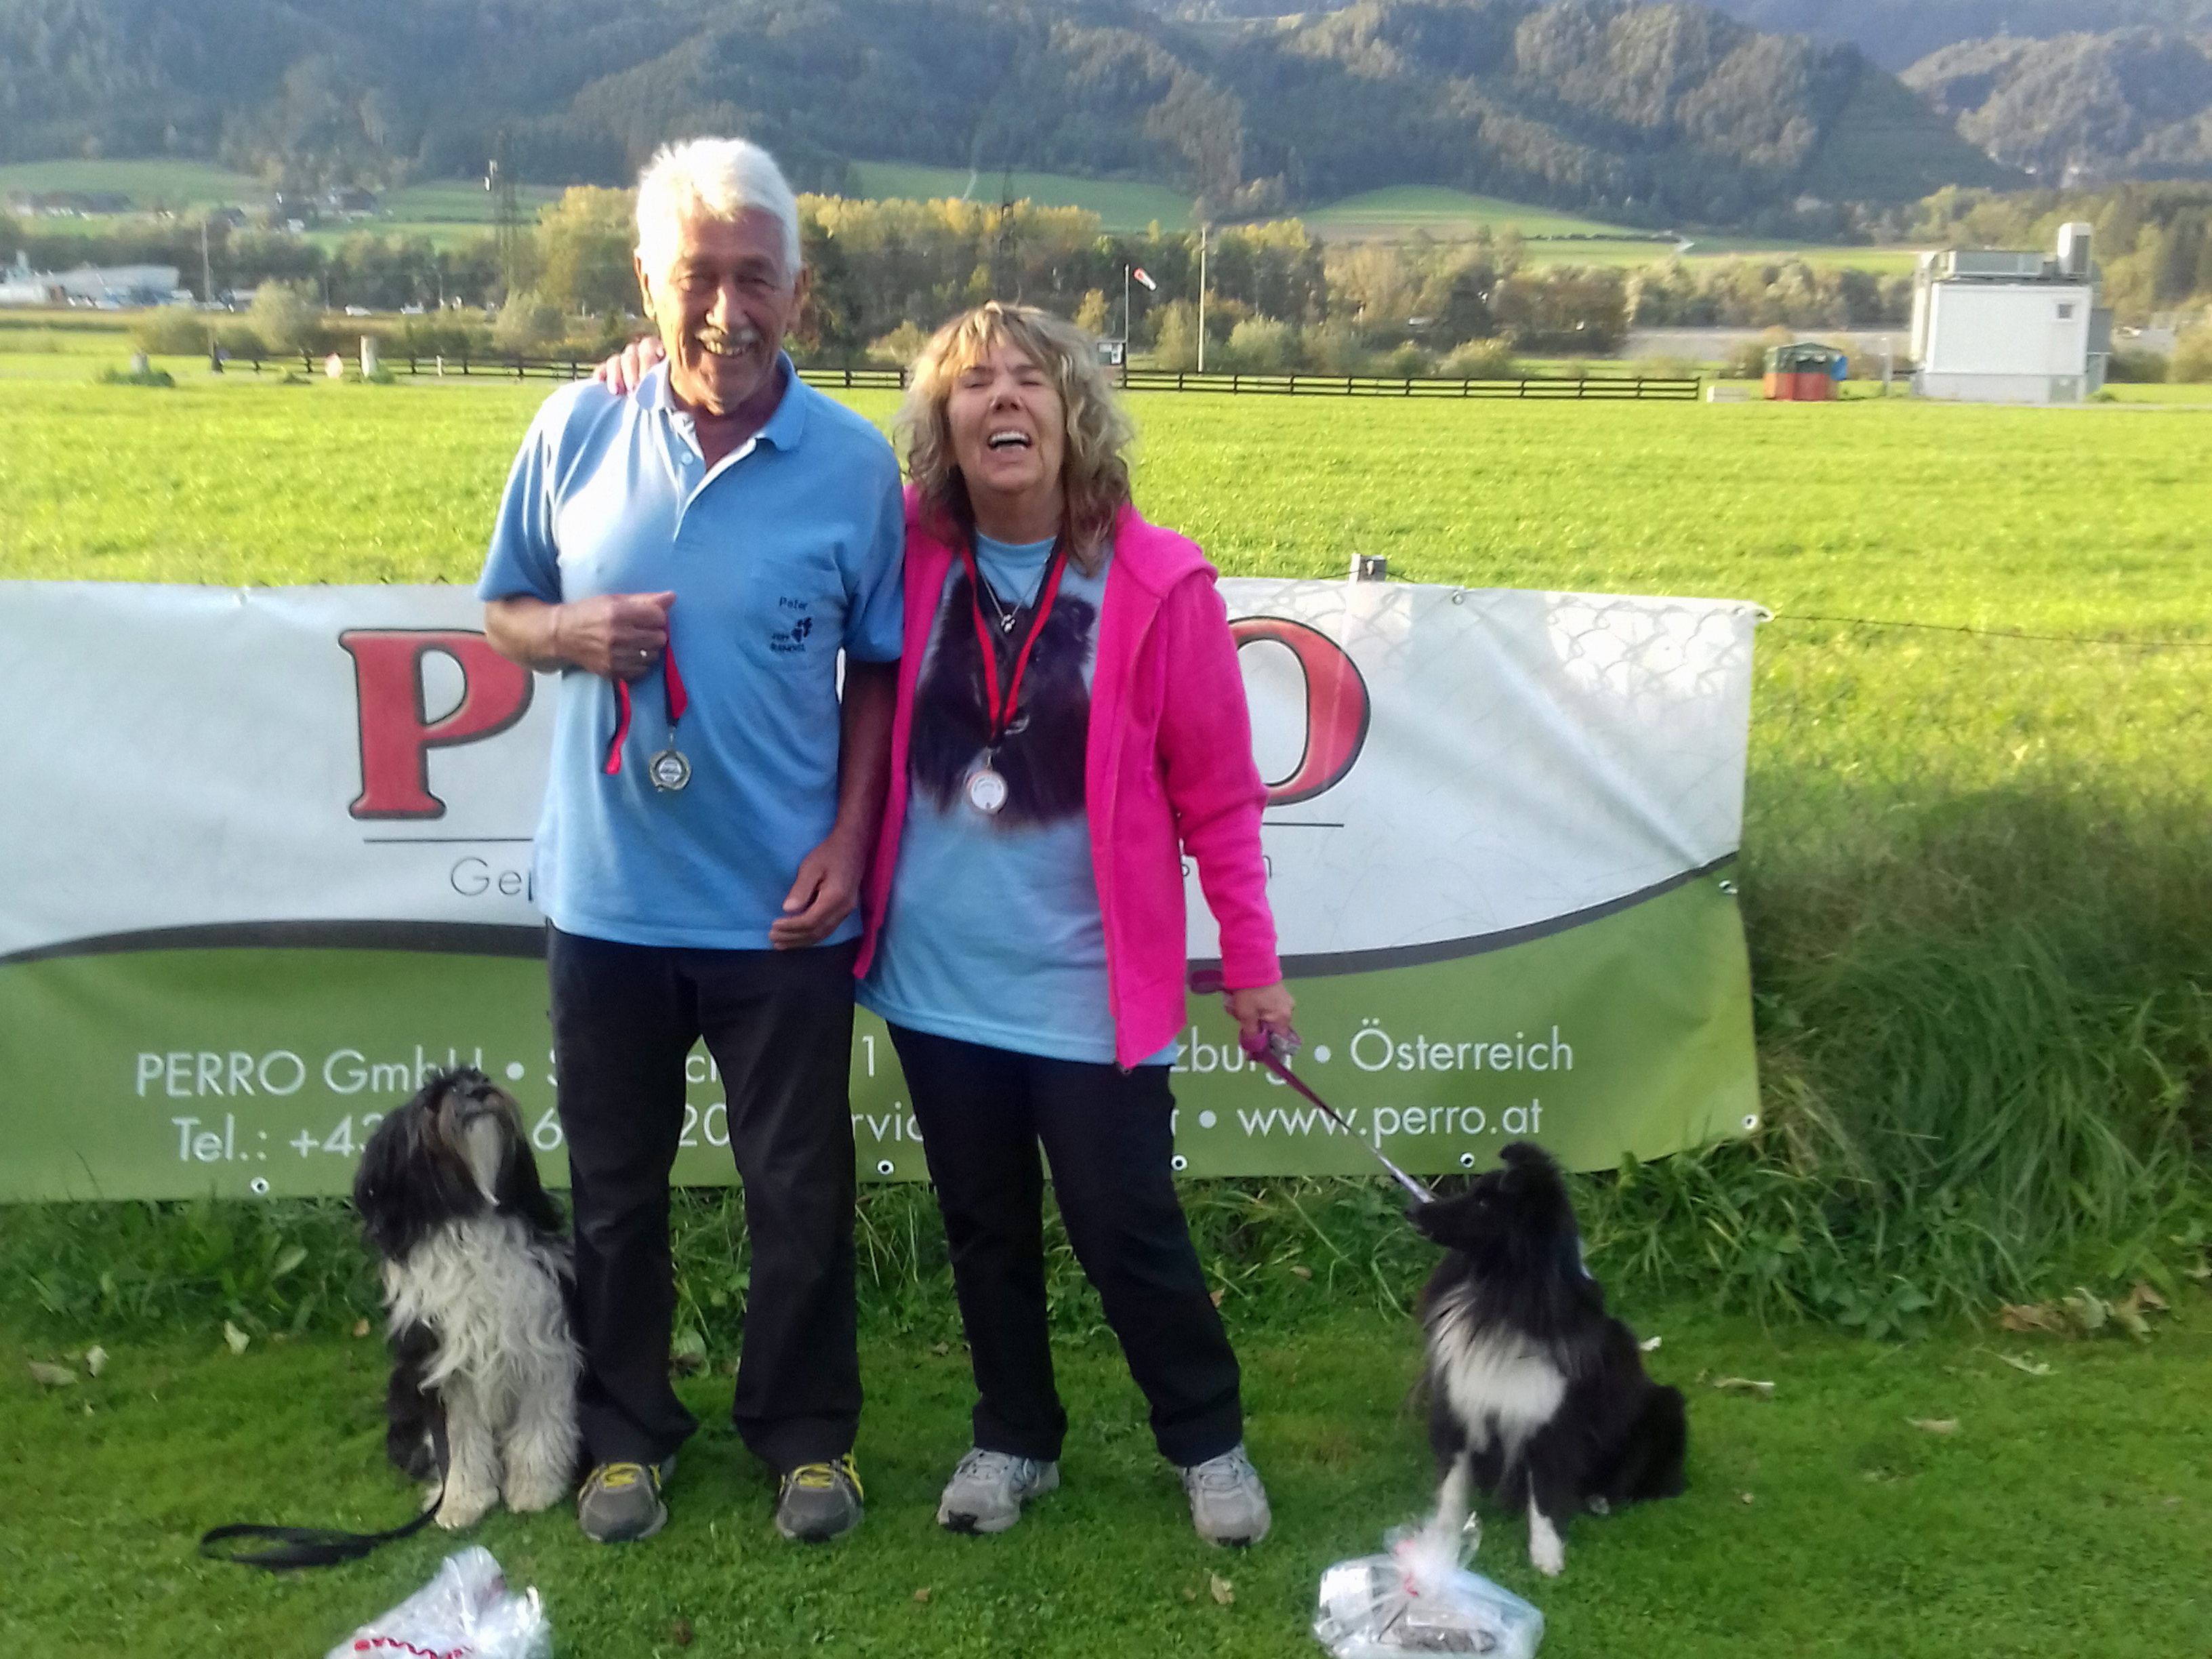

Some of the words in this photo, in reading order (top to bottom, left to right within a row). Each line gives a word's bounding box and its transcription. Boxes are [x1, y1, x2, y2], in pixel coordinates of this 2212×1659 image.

[137, 1050, 305, 1096] PERRO
[1349, 1017, 1573, 1071] Österreich
[171, 1113, 267, 1162] Tel.:
[1236, 1098, 1543, 1149] www.perro.at
